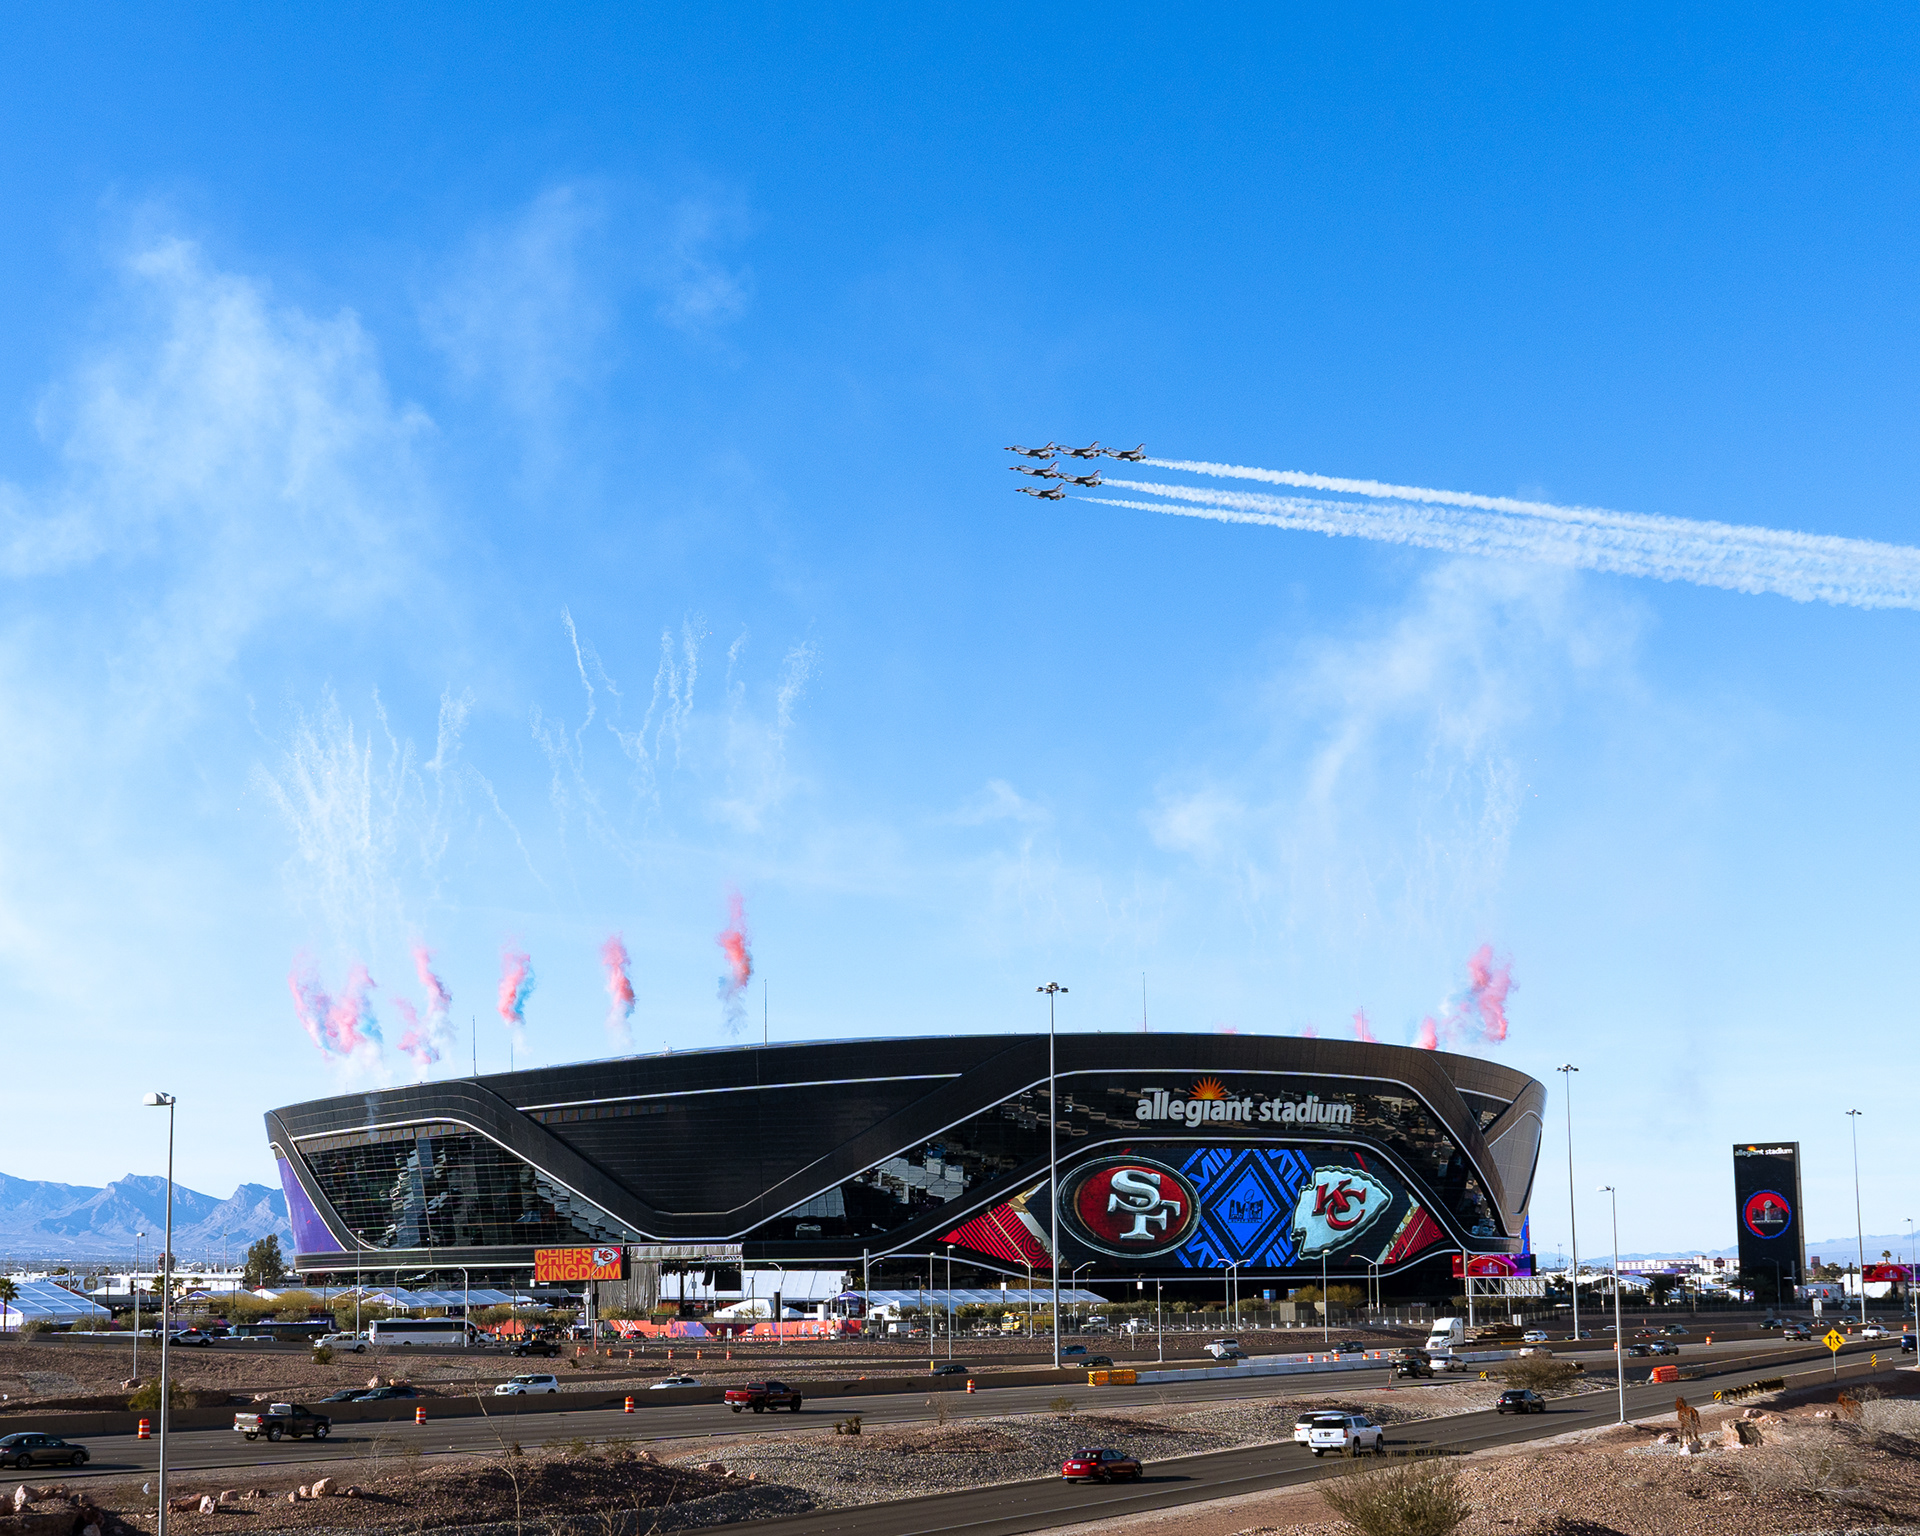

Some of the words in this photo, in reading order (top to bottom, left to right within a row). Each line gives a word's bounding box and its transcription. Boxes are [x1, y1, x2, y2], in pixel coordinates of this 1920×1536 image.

[1135, 1091, 1253, 1127] allegiant
[1259, 1095, 1352, 1124] stadium
[1765, 1147, 1793, 1155] stadium
[535, 1248, 592, 1266] CHIEFS
[537, 1262, 622, 1281] KINGDOM
